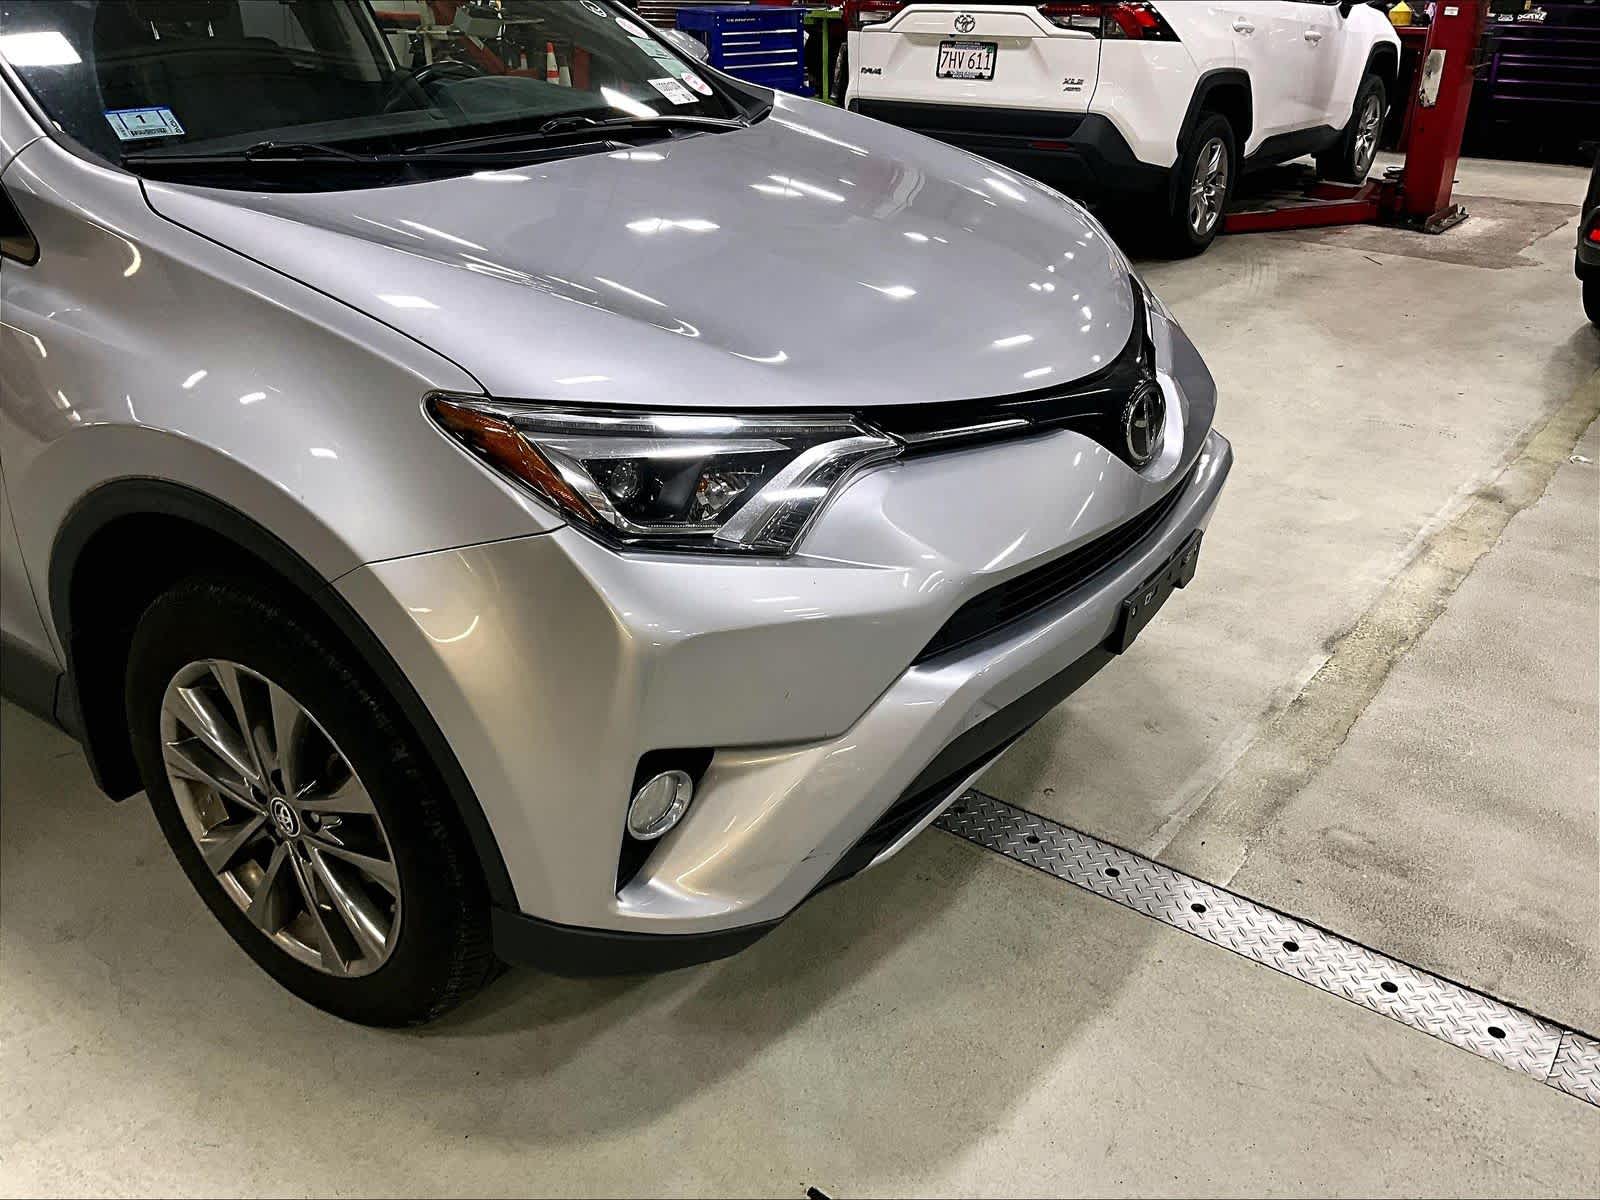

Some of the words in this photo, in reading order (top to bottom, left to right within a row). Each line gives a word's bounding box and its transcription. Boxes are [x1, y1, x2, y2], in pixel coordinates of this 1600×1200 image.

[941, 51, 965, 69] 7HV
[967, 52, 991, 70] 611
[136, 115, 146, 124] 1
